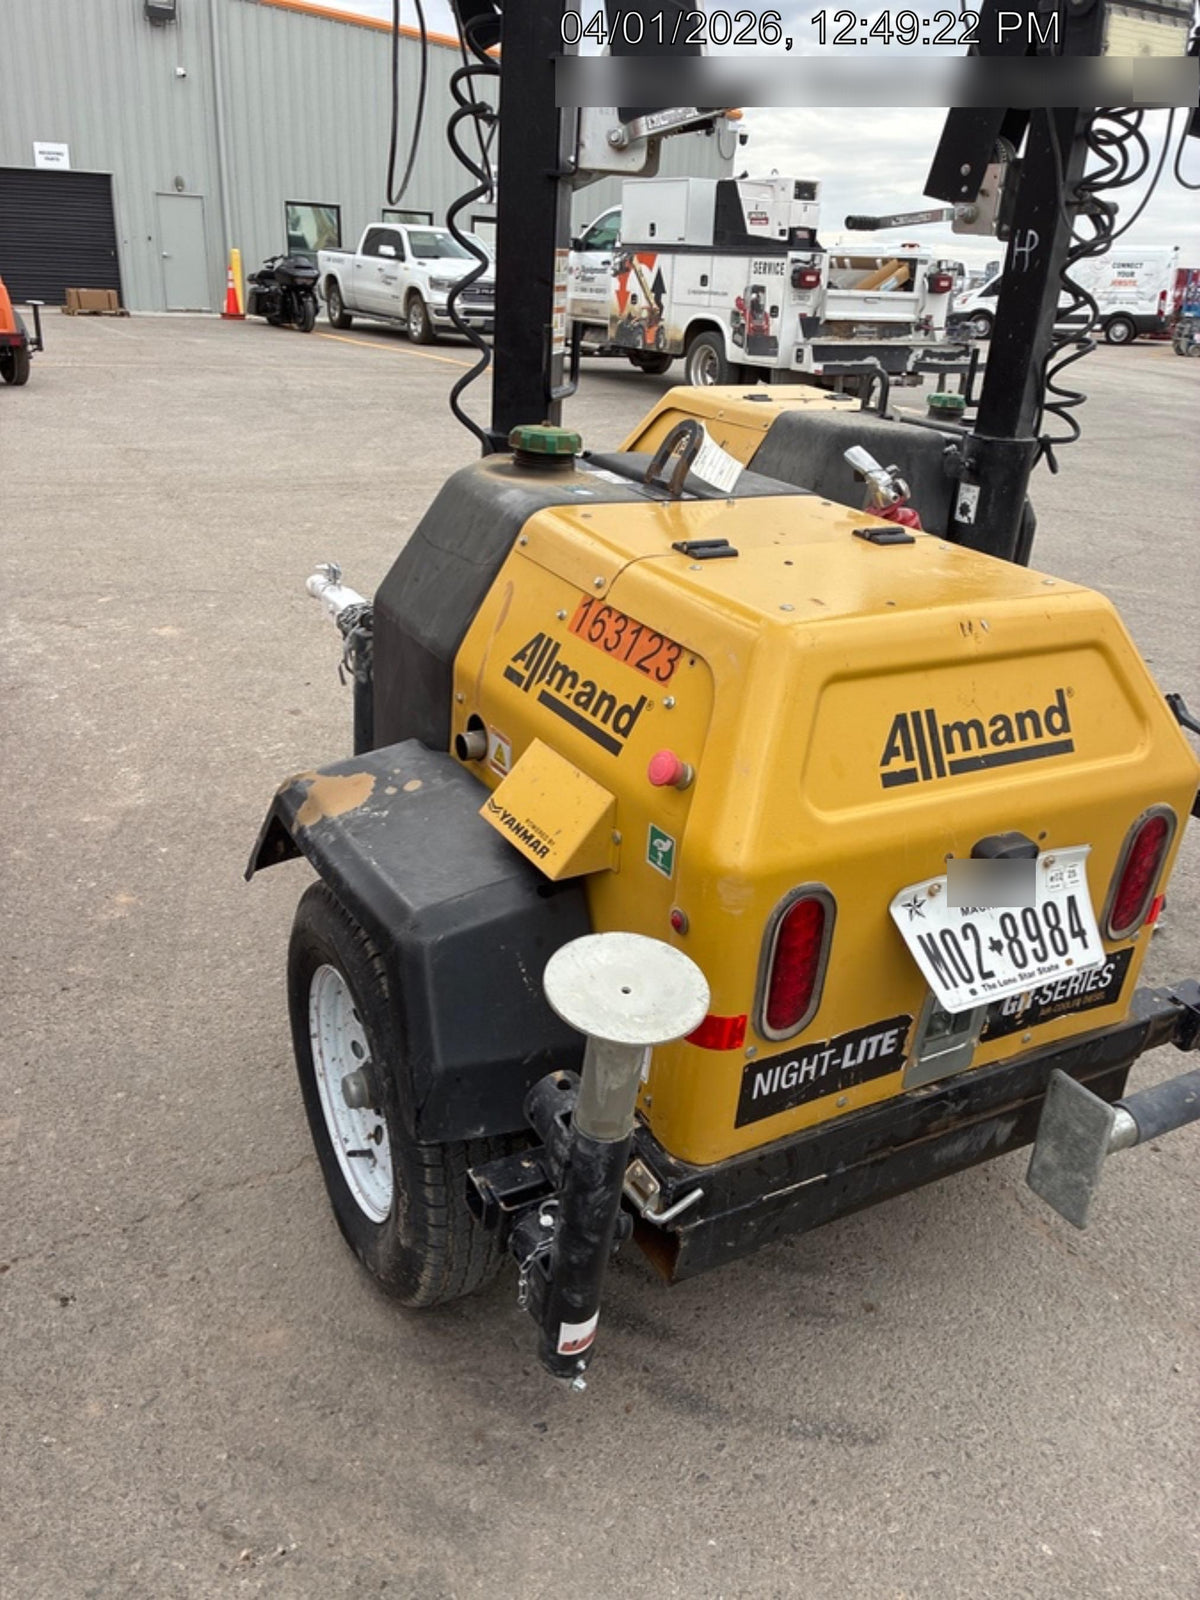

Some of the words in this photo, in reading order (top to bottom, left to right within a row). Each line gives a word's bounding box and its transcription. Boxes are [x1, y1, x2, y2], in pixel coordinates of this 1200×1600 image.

[753, 261, 785, 276] SERVICE
[575, 598, 683, 682] 163123
[511, 631, 648, 739] Allmand
[879, 688, 1071, 781] Allmand
[499, 809, 550, 859] YANMAR
[982, 981, 997, 992] The
[997, 976, 1018, 988] Lone
[1018, 969, 1036, 980] Star
[1036, 963, 1060, 976] State
[752, 1028, 899, 1100] NIGHT-LITE
